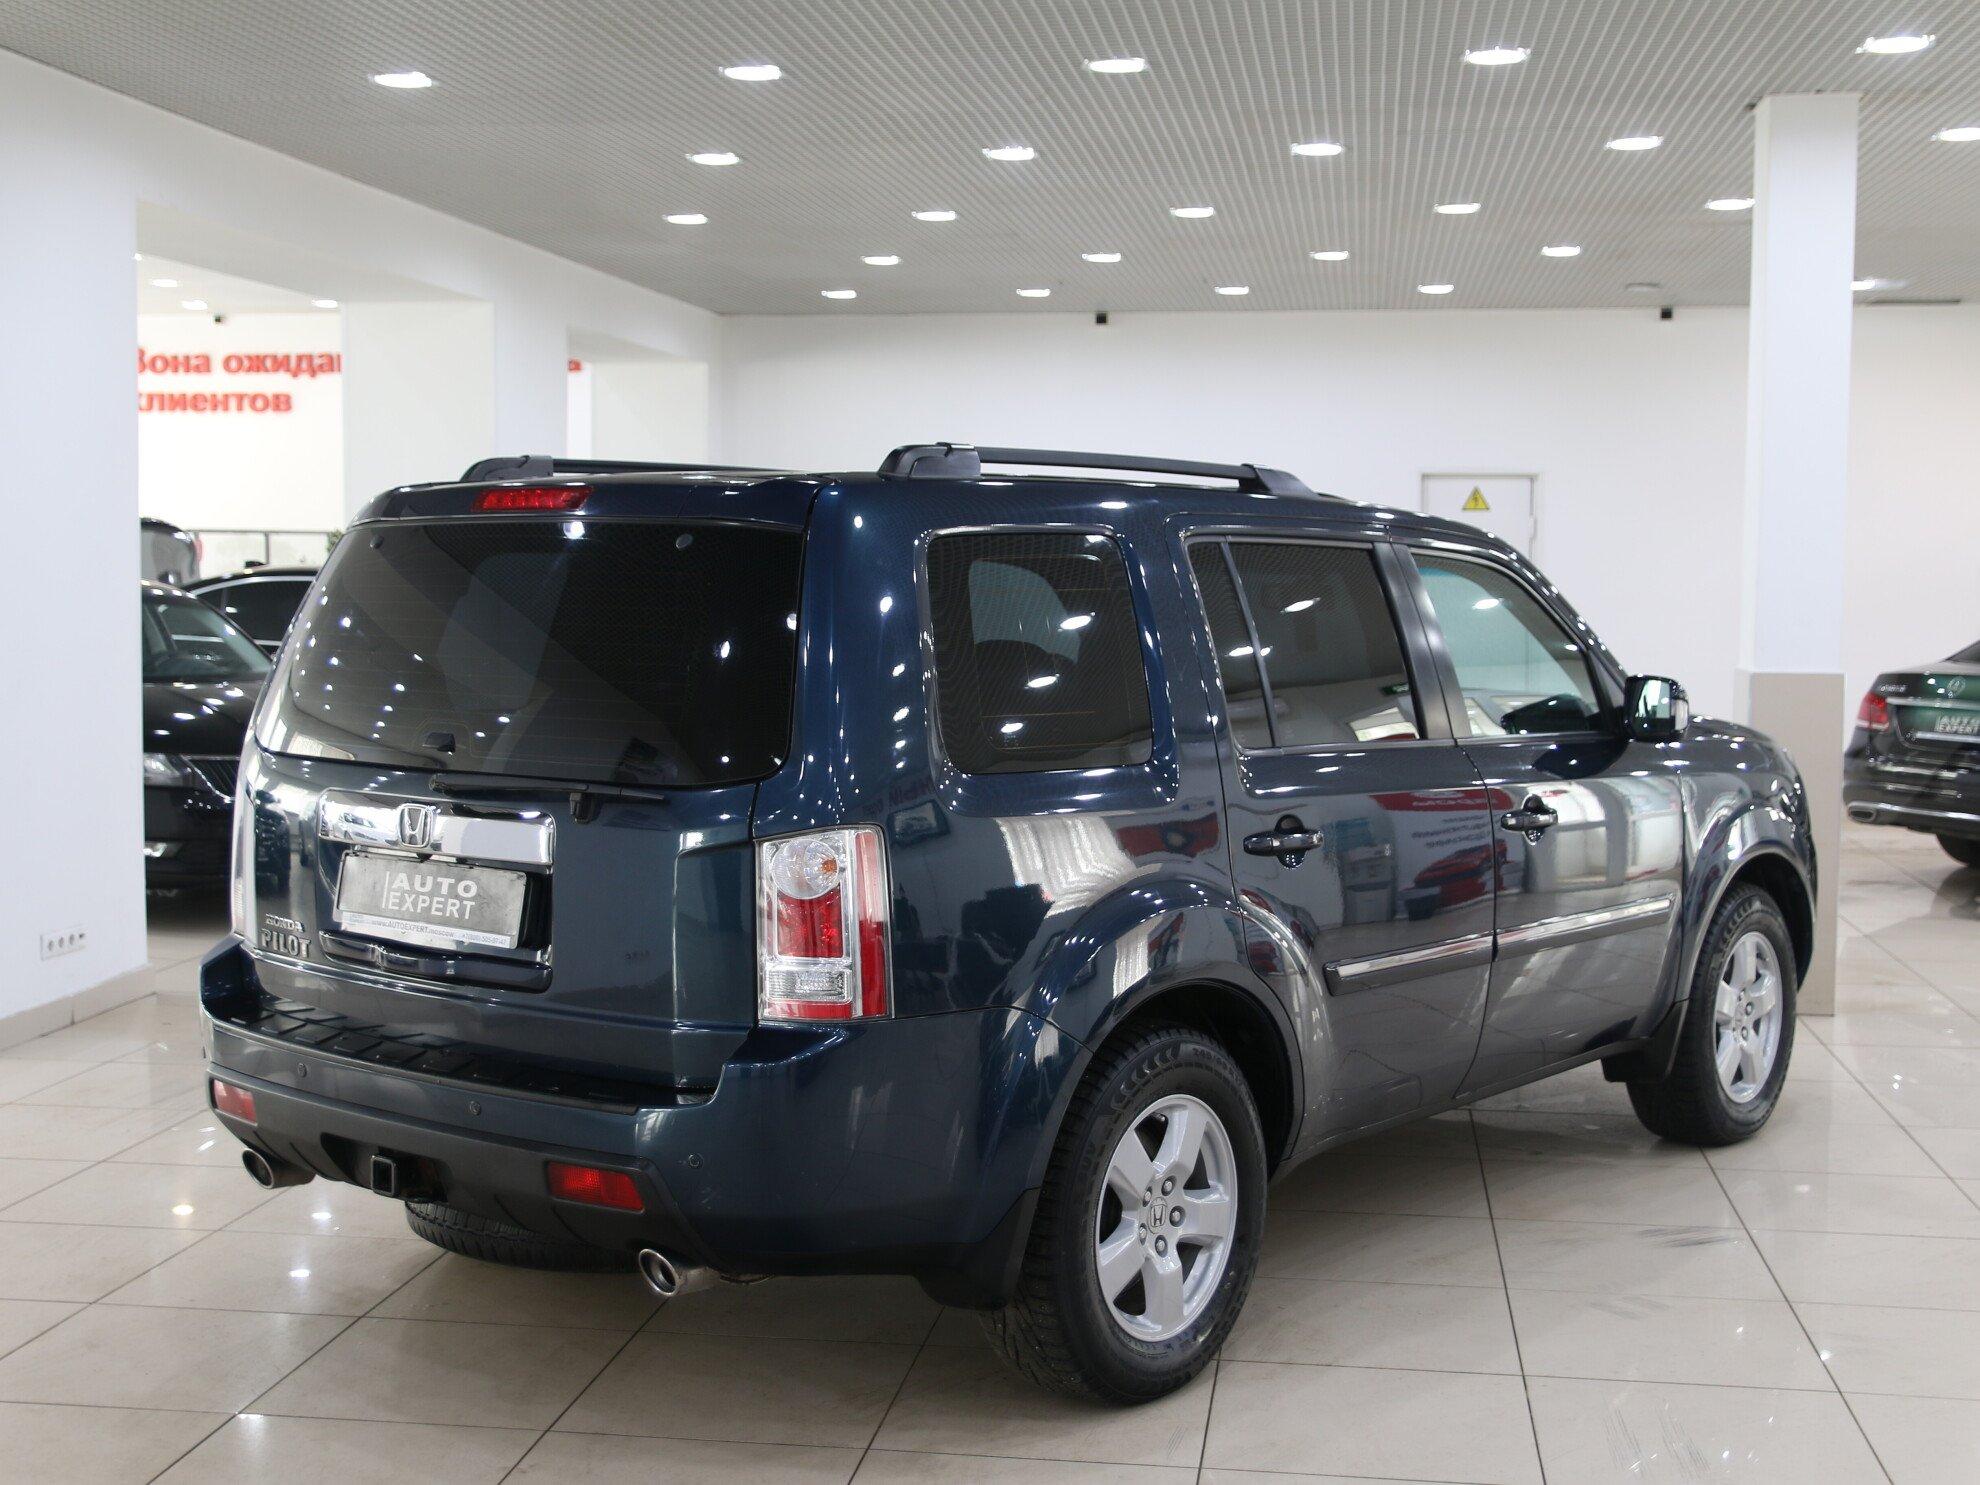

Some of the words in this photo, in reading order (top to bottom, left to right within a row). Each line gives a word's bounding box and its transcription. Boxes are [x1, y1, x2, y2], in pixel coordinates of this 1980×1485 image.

[138, 392, 292, 412] лиентов
[392, 872, 478, 898] AUTO
[389, 891, 476, 920] EXPERT
[264, 912, 304, 933] HONDA
[261, 928, 311, 958] PILOT
